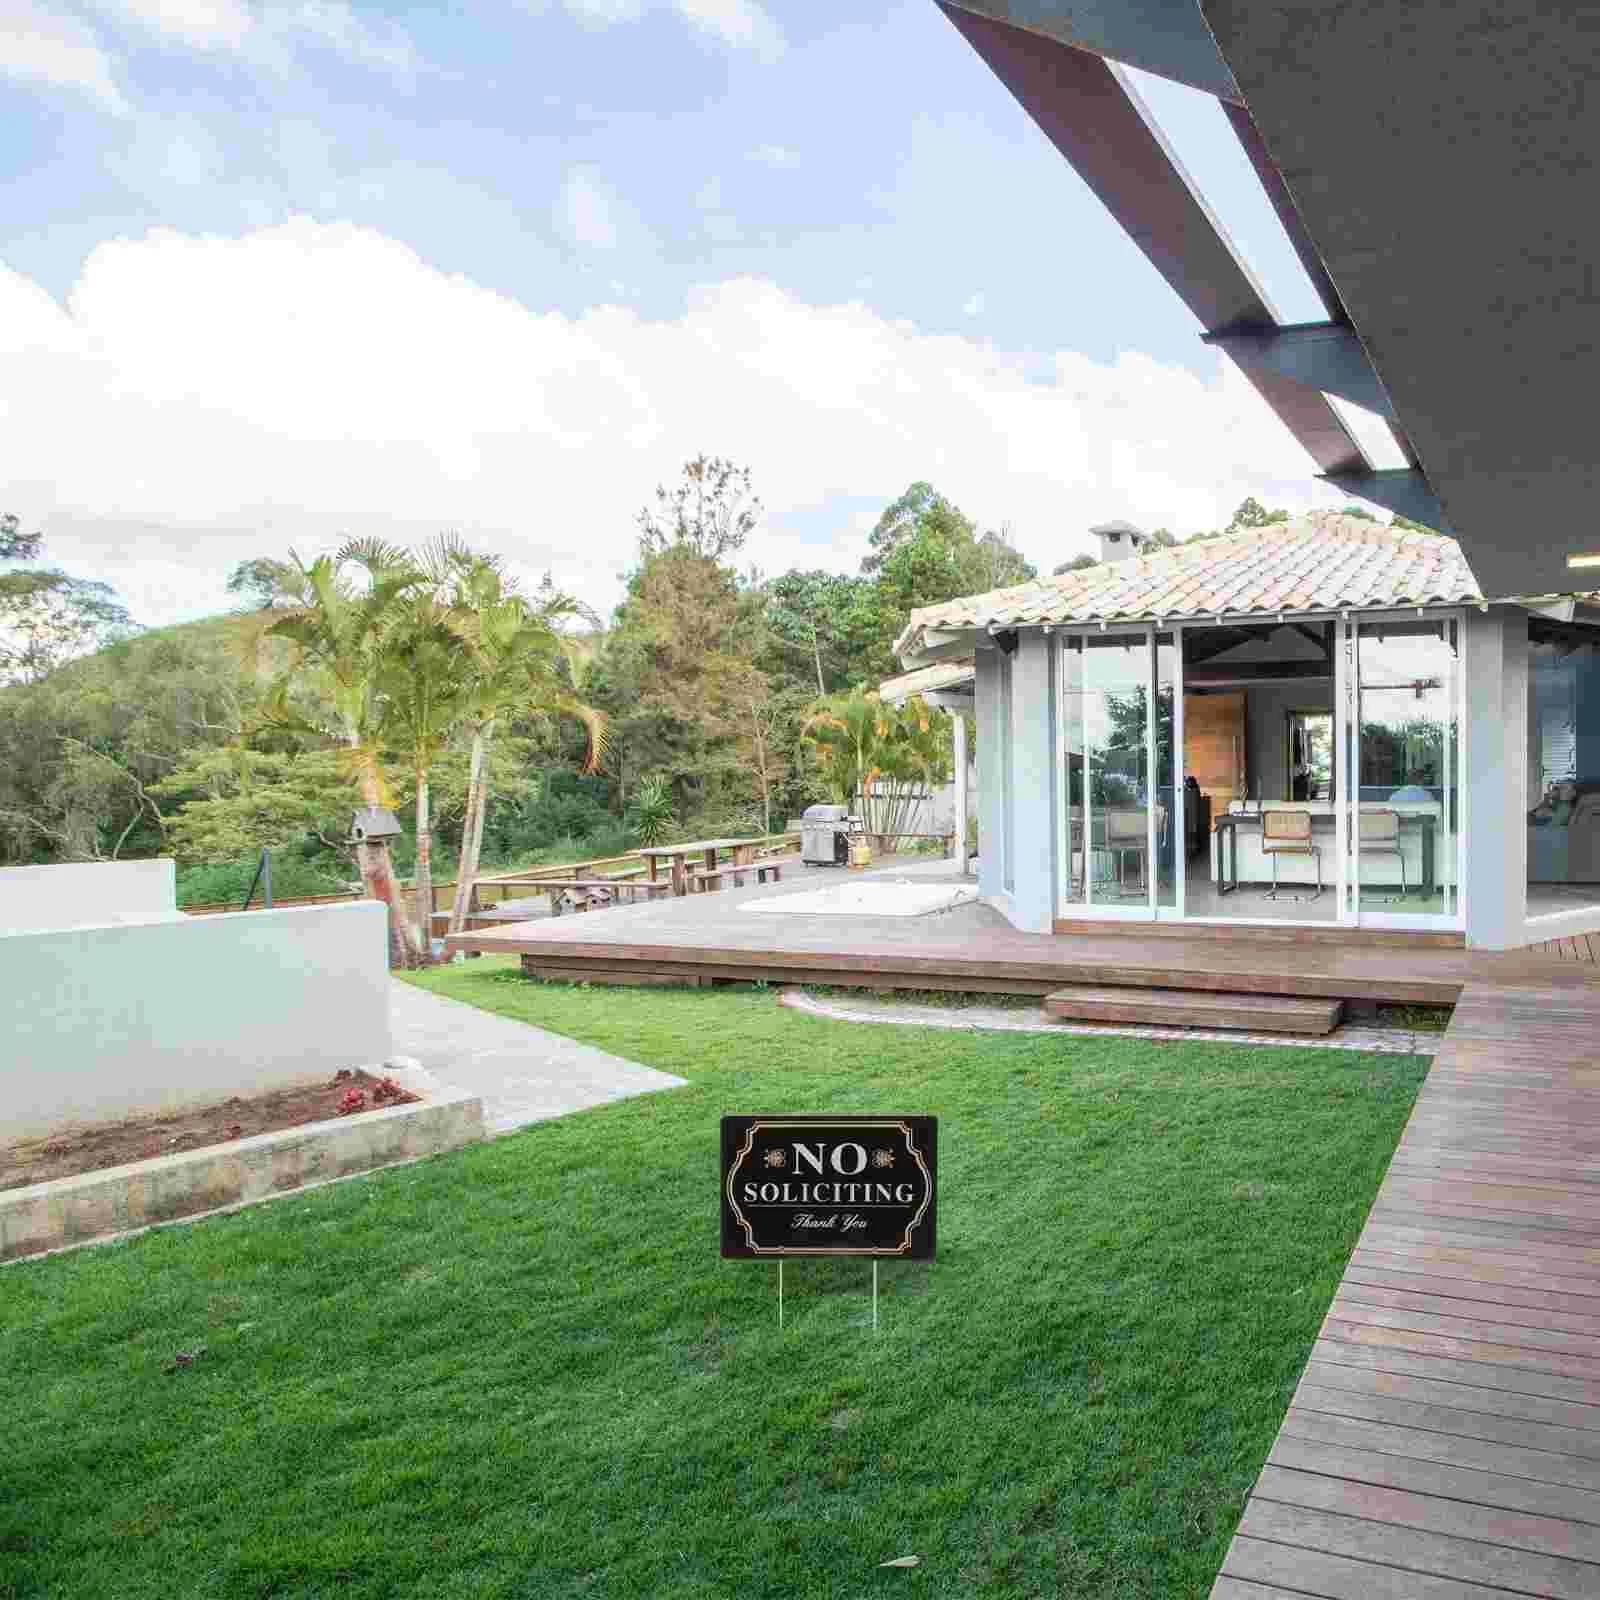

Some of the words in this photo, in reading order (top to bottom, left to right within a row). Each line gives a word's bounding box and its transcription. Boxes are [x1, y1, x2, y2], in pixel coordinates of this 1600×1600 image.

[791, 1142, 868, 1175] NO
[744, 1182, 914, 1203] SOLICITING
[790, 1213, 837, 1230] Thank
[839, 1214, 868, 1233] You
